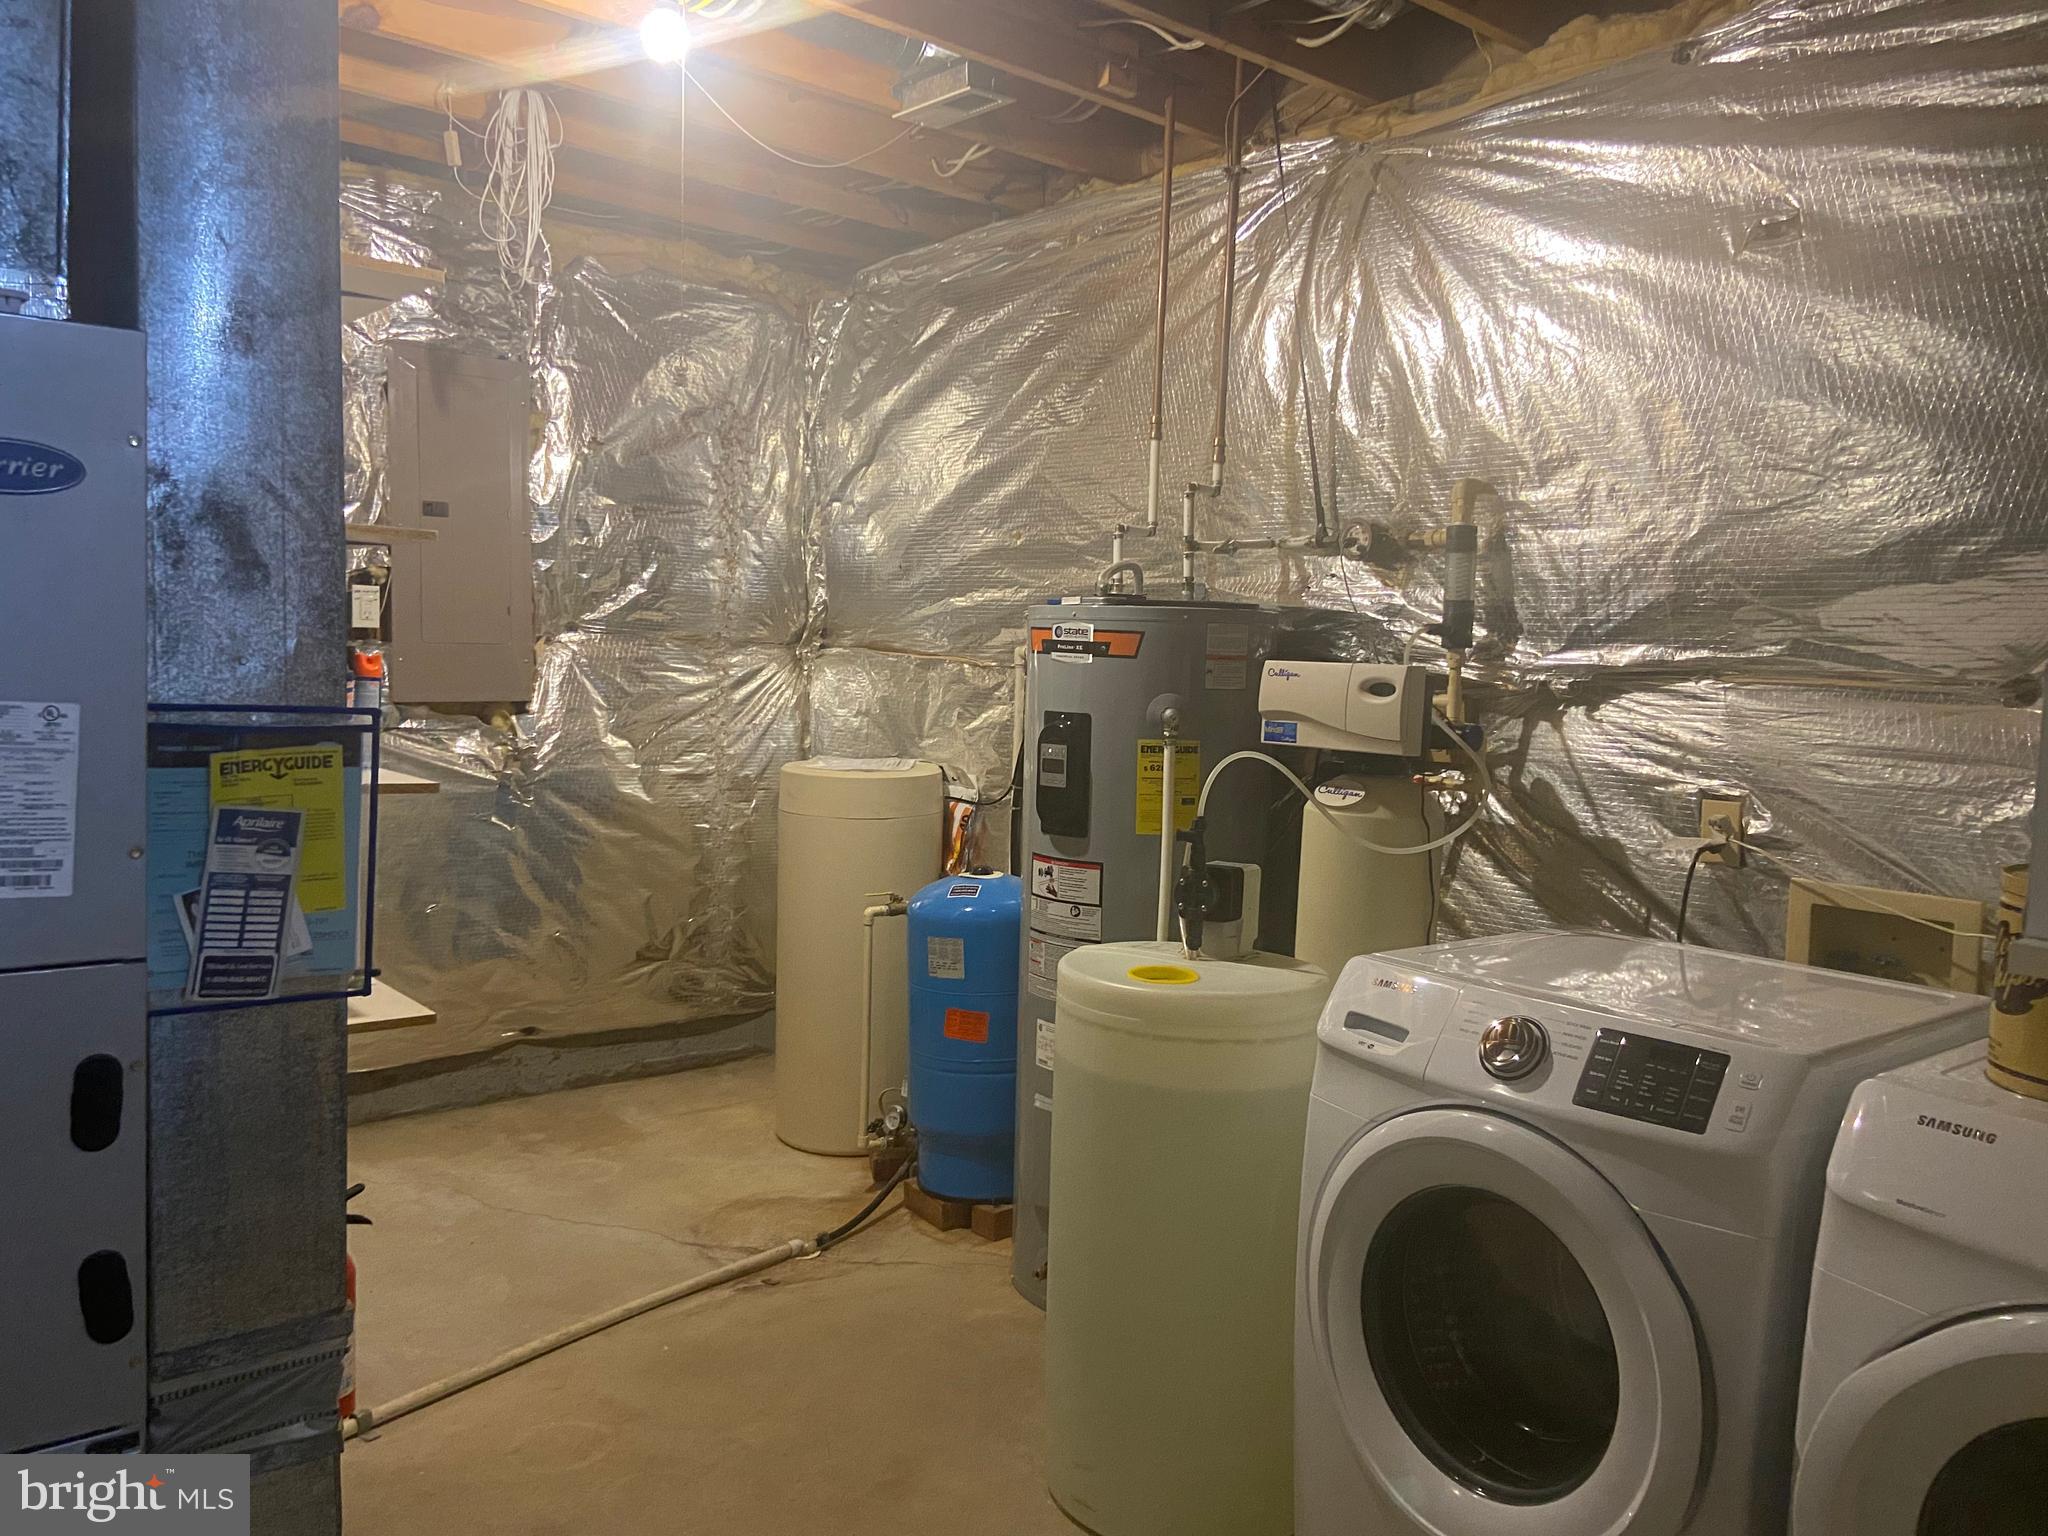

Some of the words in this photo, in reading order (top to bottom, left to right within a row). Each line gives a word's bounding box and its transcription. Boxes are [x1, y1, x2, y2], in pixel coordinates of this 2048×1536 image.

[1063, 627, 1089, 636] state
[1267, 667, 1301, 681] Culligan
[220, 755, 333, 777] ENERGYGUIDE
[1318, 785, 1363, 801] Culligan
[1916, 1114, 1998, 1145] SAMSUNG
